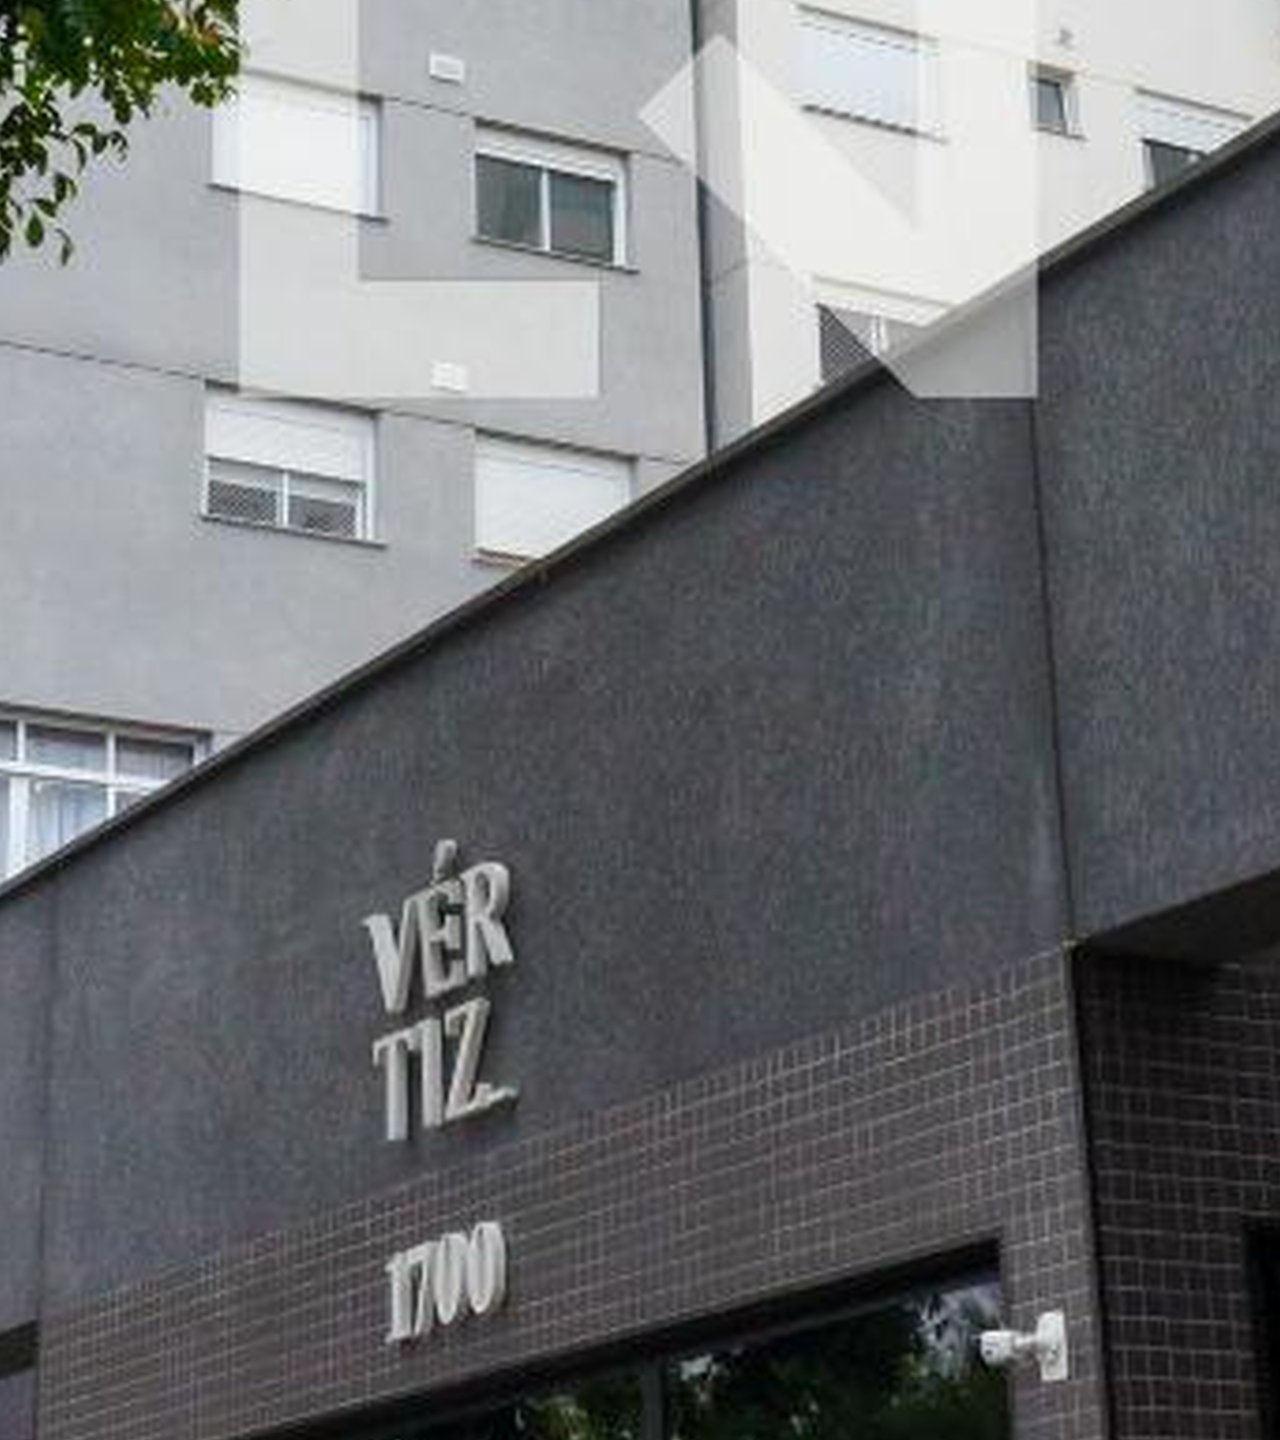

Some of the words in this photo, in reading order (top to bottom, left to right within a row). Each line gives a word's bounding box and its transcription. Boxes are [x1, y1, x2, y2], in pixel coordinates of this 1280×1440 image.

[362, 838, 515, 1013] VÉR
[372, 996, 519, 1143] TIZ
[384, 1221, 508, 1344] 1700
